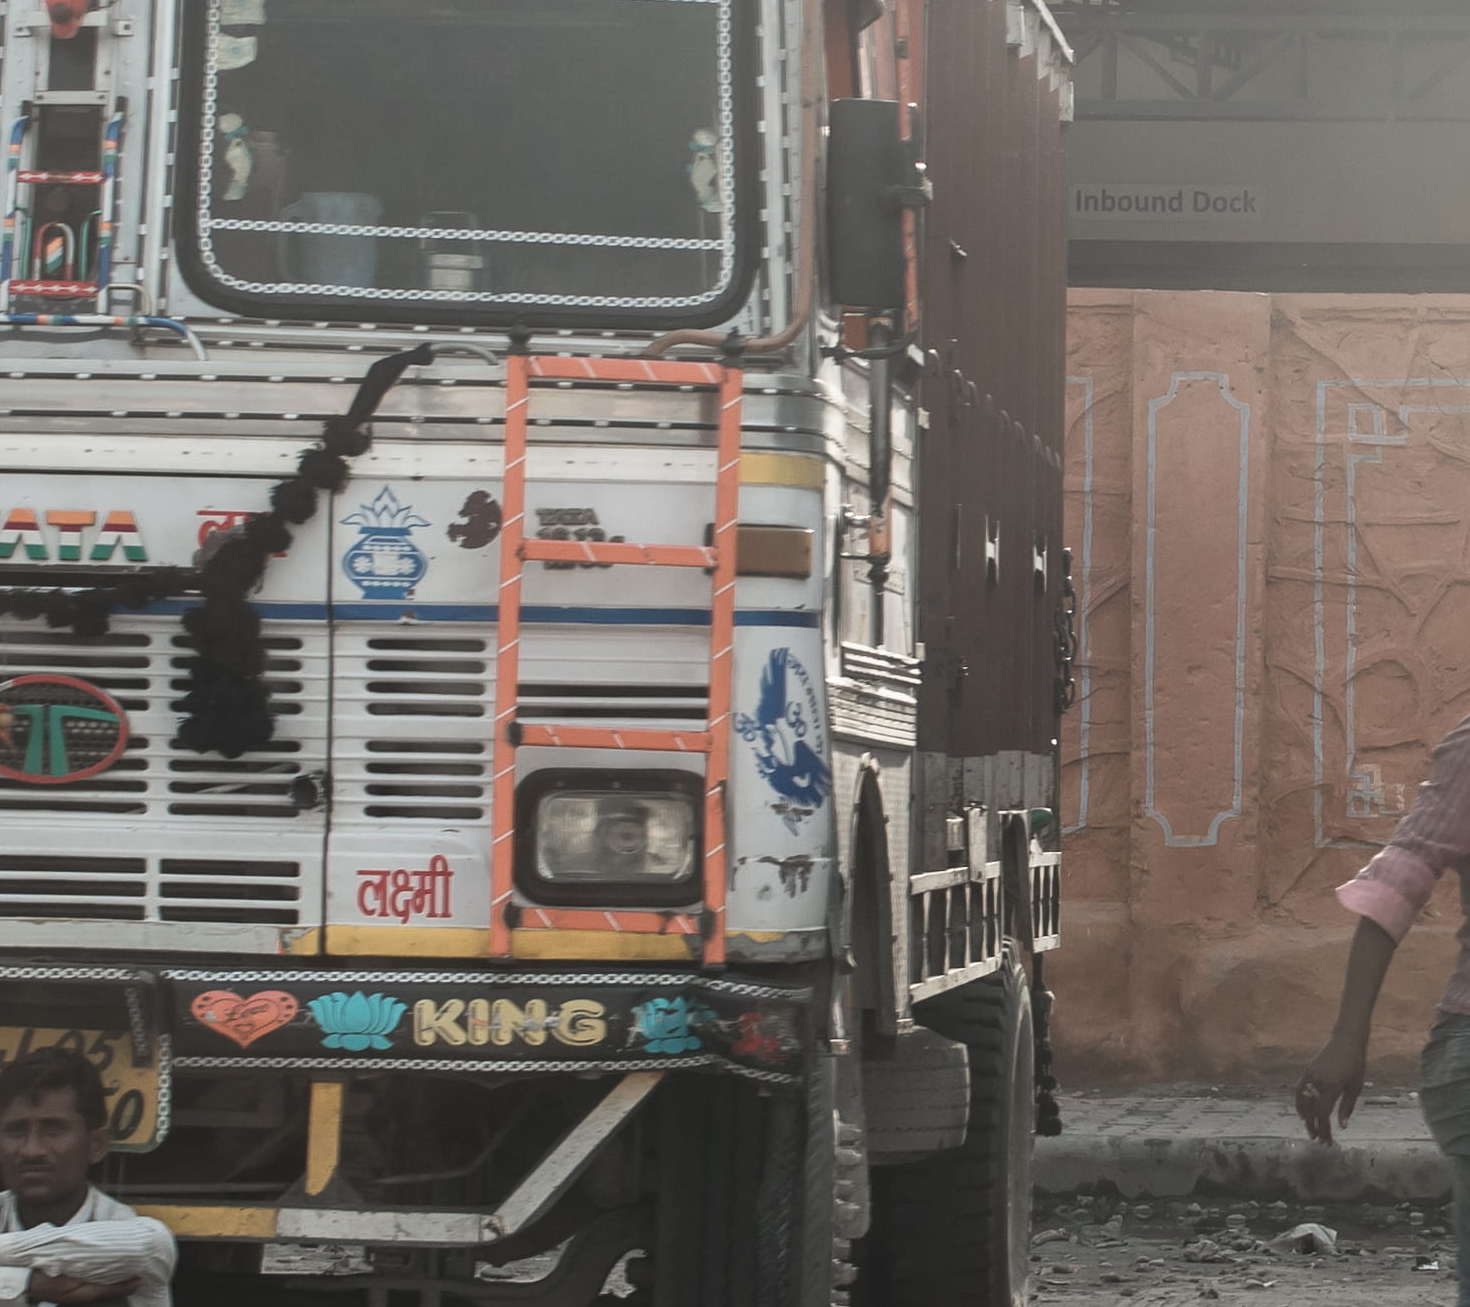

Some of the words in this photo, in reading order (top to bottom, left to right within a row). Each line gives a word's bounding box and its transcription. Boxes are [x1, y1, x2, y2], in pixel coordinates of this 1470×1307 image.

[1075, 189, 1183, 213] Inbound
[1192, 189, 1257, 213] Dock
[355, 854, 455, 925] लक्ष्मी
[414, 998, 607, 1046] KING
